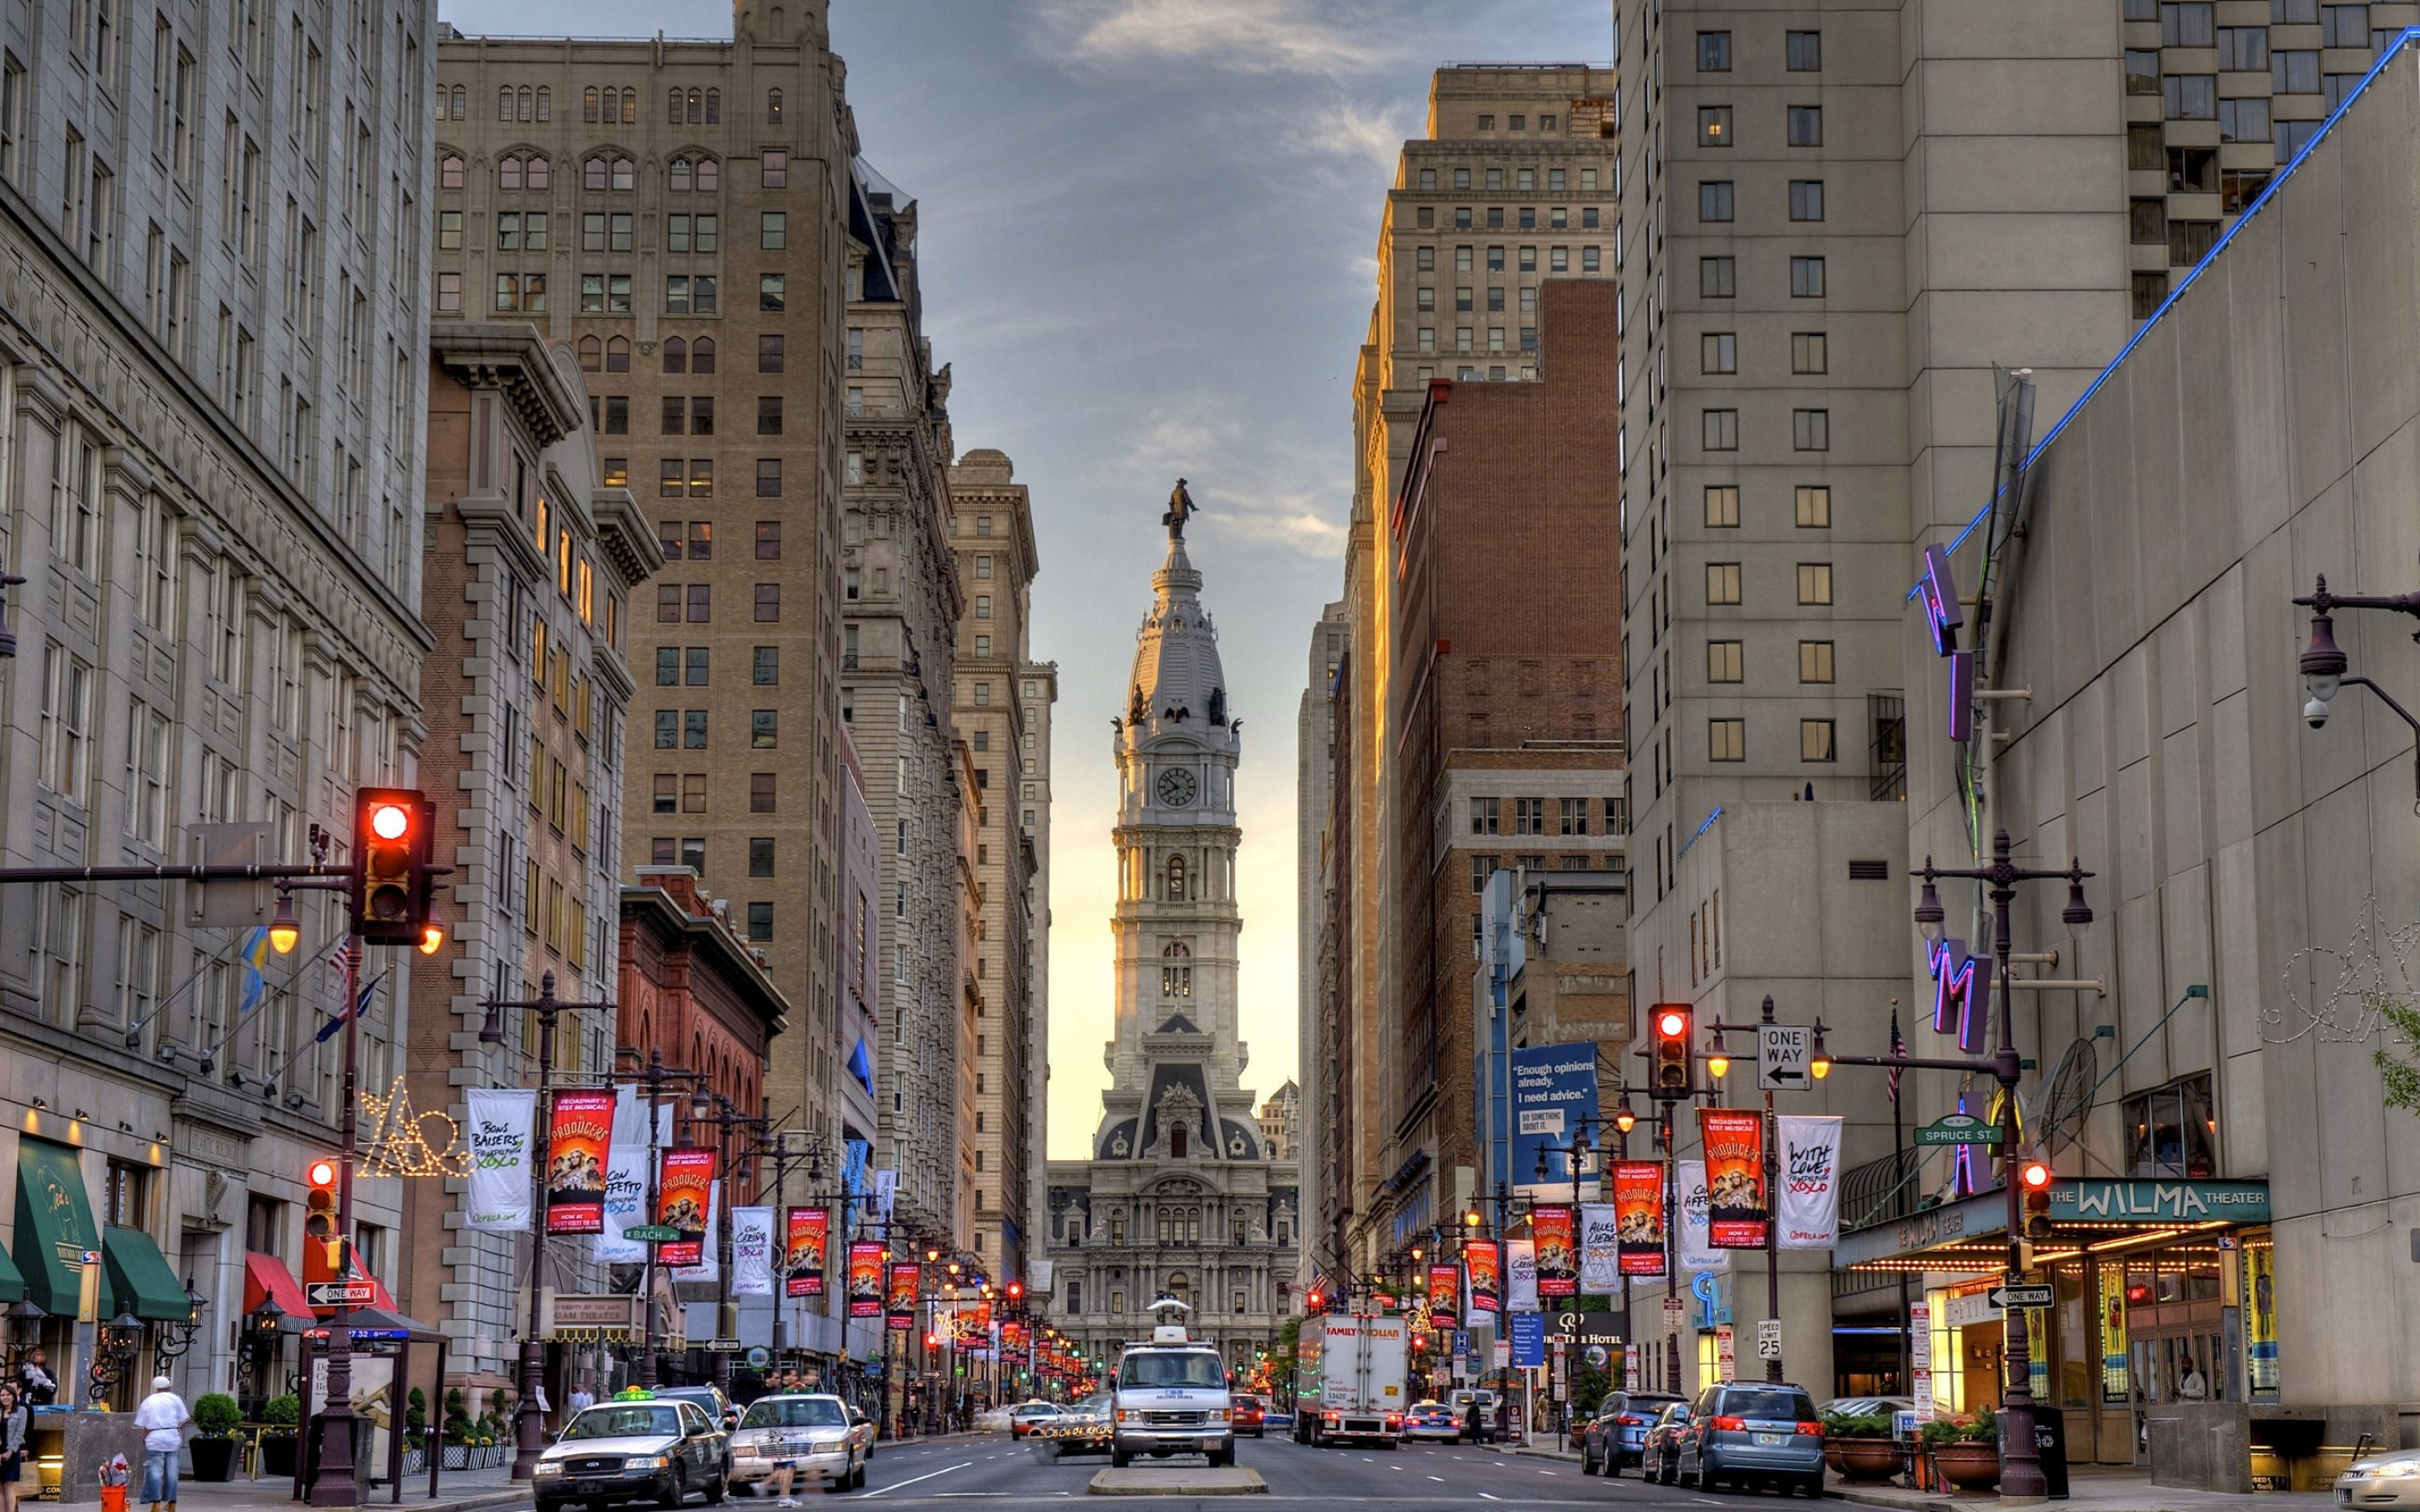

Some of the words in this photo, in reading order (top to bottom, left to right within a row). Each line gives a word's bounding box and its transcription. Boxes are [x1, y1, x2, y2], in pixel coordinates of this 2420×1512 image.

[1769, 1031, 1801, 1046] ONE
[1767, 1048, 1802, 1063] WAY
[1555, 1061, 1595, 1074] opinions
[1518, 1076, 1555, 1089] already.
[1518, 1093, 1523, 1104] I
[1524, 1091, 1548, 1103] need
[1522, 1113, 1529, 1122] DO
[1531, 1111, 1561, 1122] SOMETHING
[481, 1121, 509, 1135] BONS
[551, 1121, 608, 1142] PRODUCERS
[1522, 1121, 1539, 1131] ABOUT
[471, 1133, 518, 1147] BAISERS
[1925, 1131, 1972, 1141] SPRUCE
[1977, 1131, 1993, 1140] ST.
[1707, 1142, 1760, 1163] PRODUCERS
[1789, 1142, 1833, 1163] WITH
[607, 1168, 629, 1181] CON
[1790, 1161, 1823, 1175] LOVE
[605, 1181, 642, 1194] FFETTO
[1790, 1181, 1828, 1194] XOXO
[1617, 1189, 1660, 1204] PRODUCERS
[2049, 1191, 2075, 1202] THE
[2079, 1183, 2208, 1217] WILMA
[2204, 1192, 2265, 1204] THEATER
[1589, 1221, 1614, 1233] ALLES
[634, 1231, 662, 1239] BACH
[1587, 1232, 1617, 1243] LIEBE
[327, 1289, 346, 1299] ONE
[350, 1289, 367, 1297] WAY
[2007, 1293, 2025, 1301] ONE
[2028, 1292, 2045, 1300] WAY
[580, 1311, 620, 1320] THEATER
[1326, 1327, 1356, 1336] FAMILY
[1366, 1329, 1399, 1337] DOLLAR
[1457, 1336, 1467, 1346] H
[1589, 1334, 1622, 1344] HOTEL
[1760, 1341, 1780, 1355] 25
